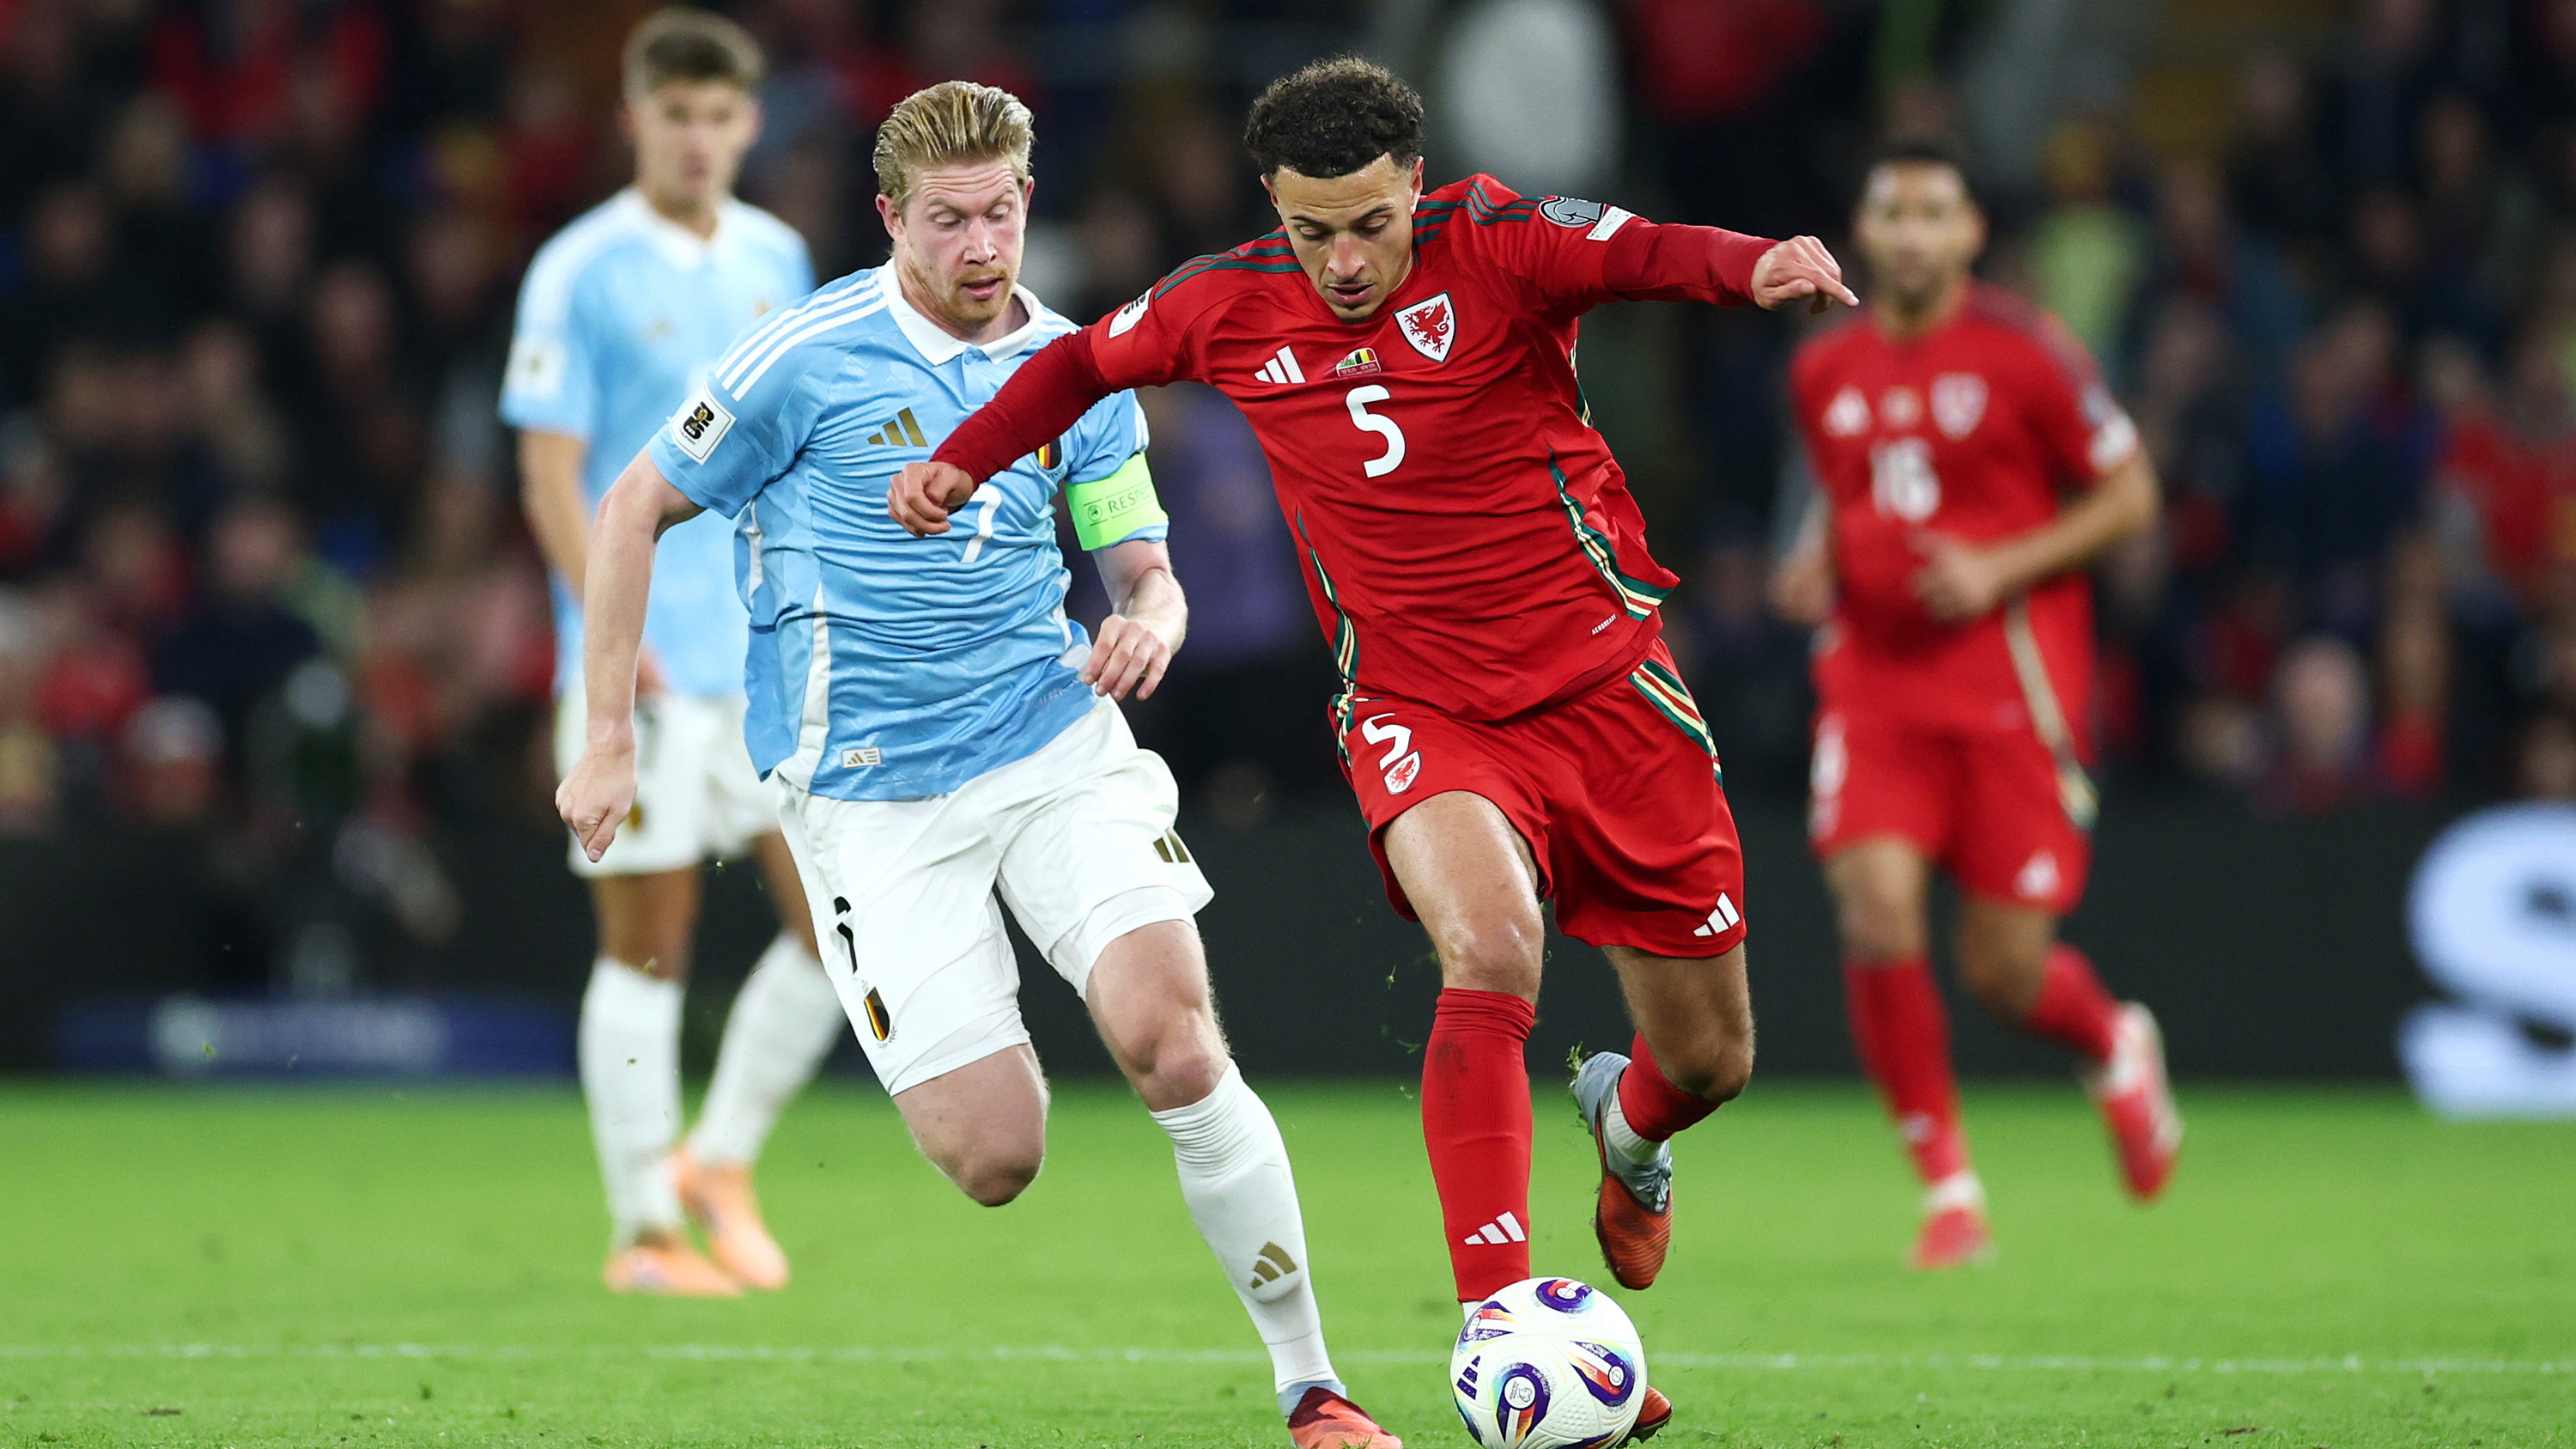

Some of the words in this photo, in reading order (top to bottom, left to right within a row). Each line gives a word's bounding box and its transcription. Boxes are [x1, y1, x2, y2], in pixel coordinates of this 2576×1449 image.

[1346, 384, 1406, 478] 5
[1870, 436, 1941, 521] 16
[961, 482, 1002, 563] 7
[1361, 712, 1413, 771] 5
[2400, 804, 2576, 1119] S
